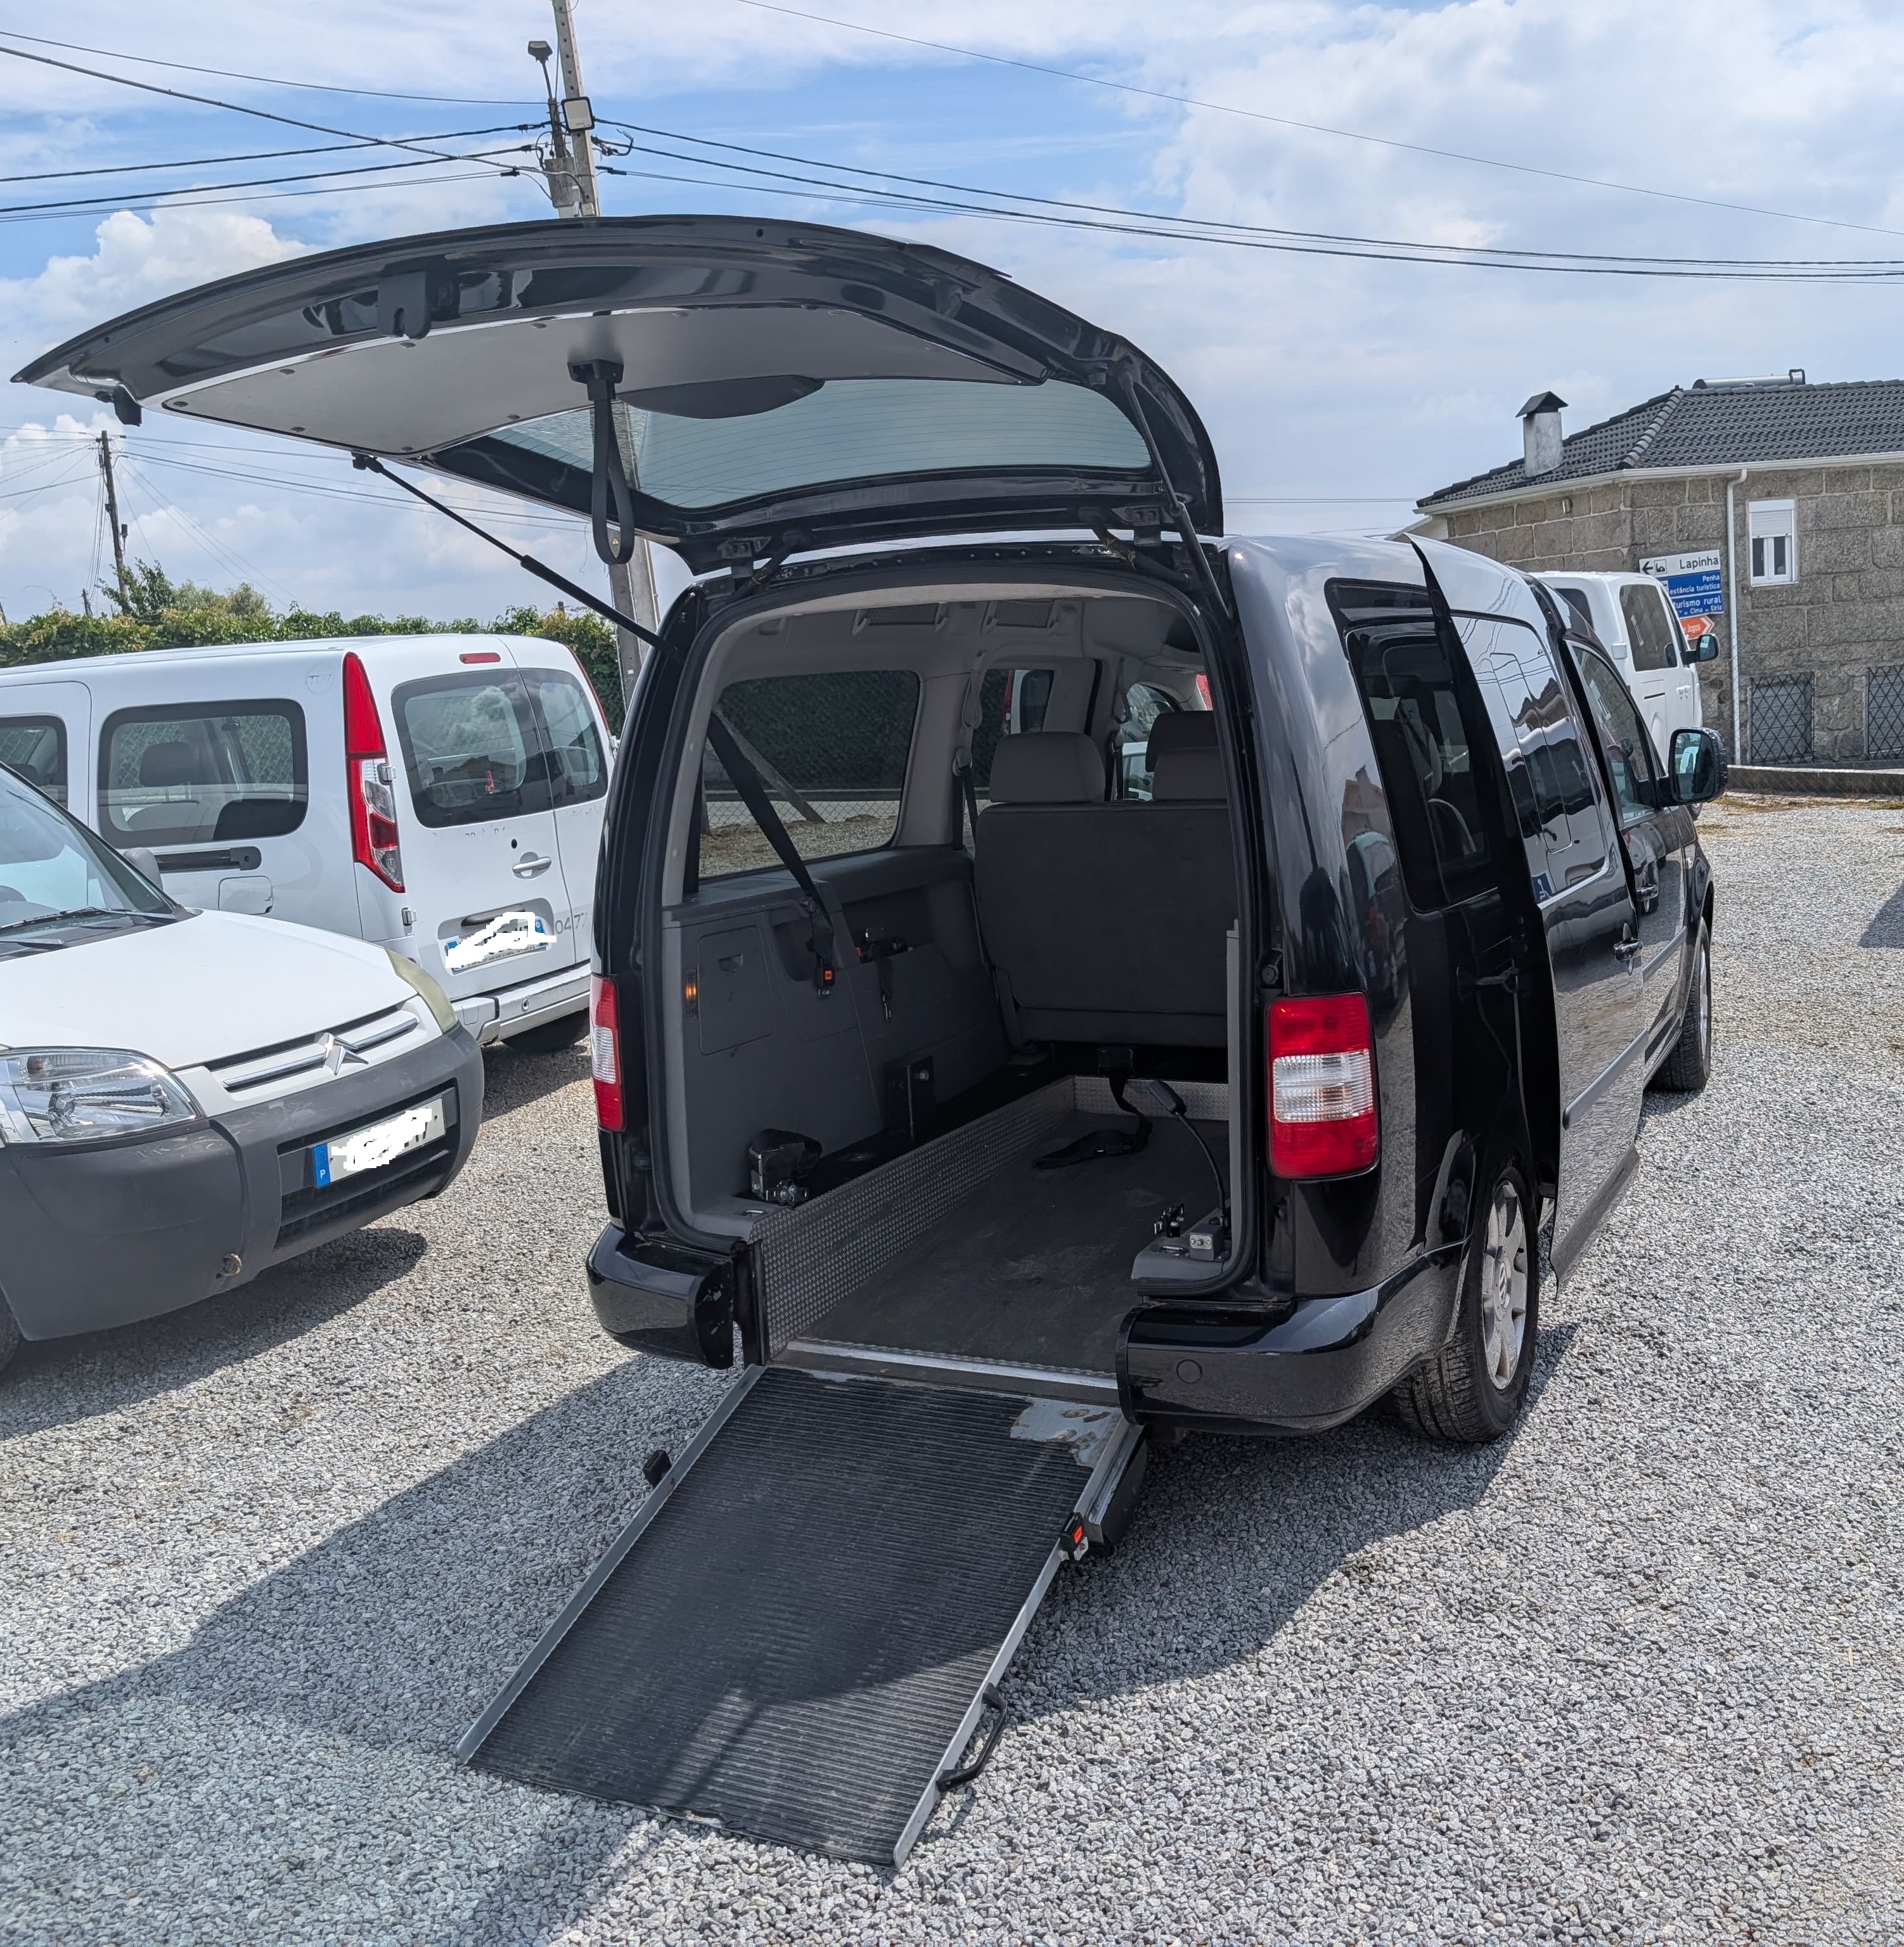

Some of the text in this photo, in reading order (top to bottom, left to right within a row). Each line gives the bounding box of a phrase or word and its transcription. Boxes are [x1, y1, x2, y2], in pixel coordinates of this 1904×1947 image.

[1680, 556, 1719, 570] Lapinha
[1669, 583, 1720, 594] estância turística
[1673, 595, 1721, 609] turismo rural
[319, 1169, 326, 1179] P
